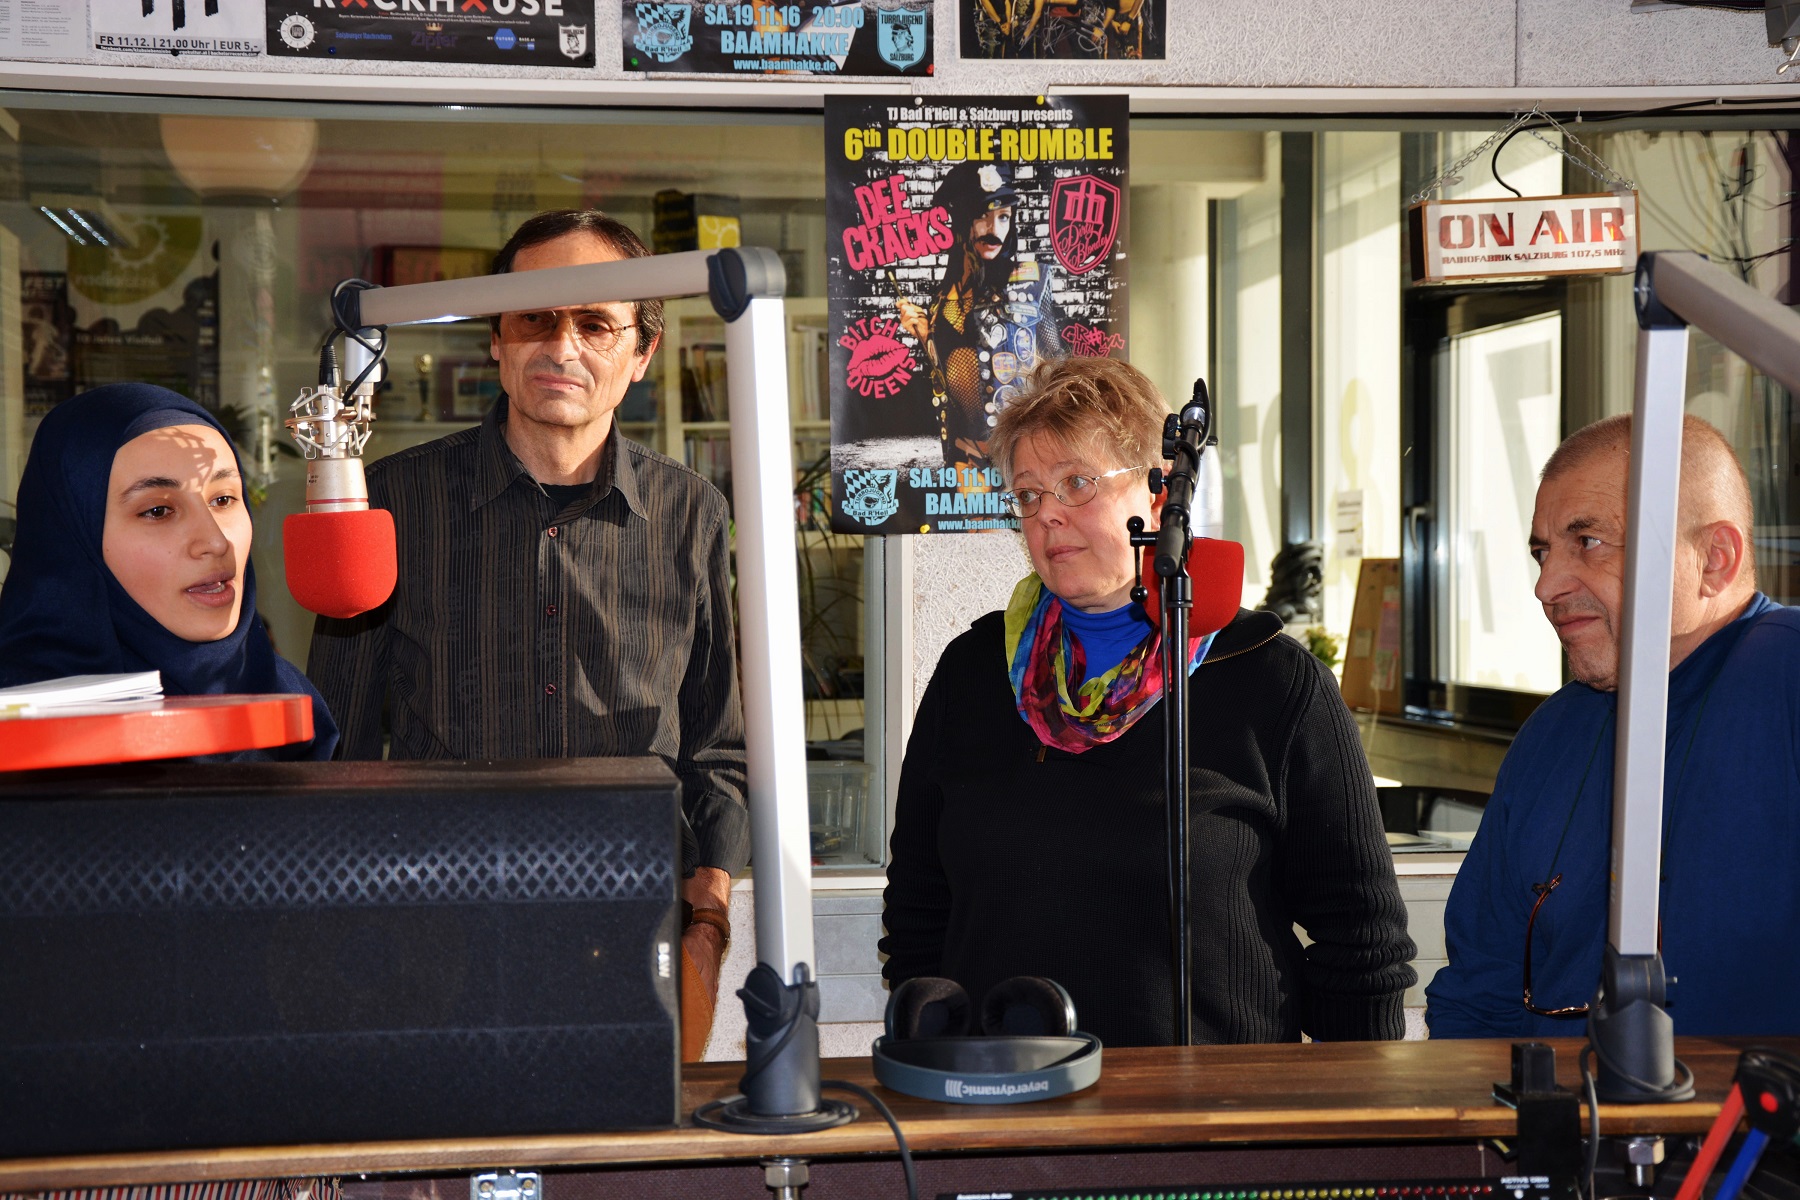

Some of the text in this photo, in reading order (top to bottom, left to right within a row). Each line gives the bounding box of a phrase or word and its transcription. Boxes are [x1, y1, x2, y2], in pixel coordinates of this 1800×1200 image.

[704, 4, 864, 29] SA.19.11.16 20:00
[100, 35, 114, 45] FR
[117, 37, 149, 47] 11.12.
[159, 39, 188, 48] 21.00
[191, 40, 210, 49] Uhr
[220, 41, 241, 50] EUR
[411, 30, 458, 51] Zipfer
[721, 30, 849, 56] BAAMHAKKE
[733, 59, 836, 72] www.baamhakke.de
[887, 107, 1073, 123] TJ Bad R'Hell & Salzburg presents
[844, 127, 1114, 161] 6th DOUBLE RUMBLE
[854, 173, 913, 230] DEE
[842, 205, 955, 272] CRACKS
[1438, 207, 1627, 250] ON AIR
[1442, 247, 1627, 264] RADIOFABRIK SALZBURG 107,5 MHz
[839, 316, 899, 353] BITCH
[846, 353, 917, 399] QUEENS
[909, 467, 1003, 488] SA.19.11.16
[854, 487, 886, 505] TURBOJUGEND
[868, 509, 889, 517] R'Hell
[657, 941, 670, 978] B&W
[962, 1080, 1049, 1097] beyerdynamic
